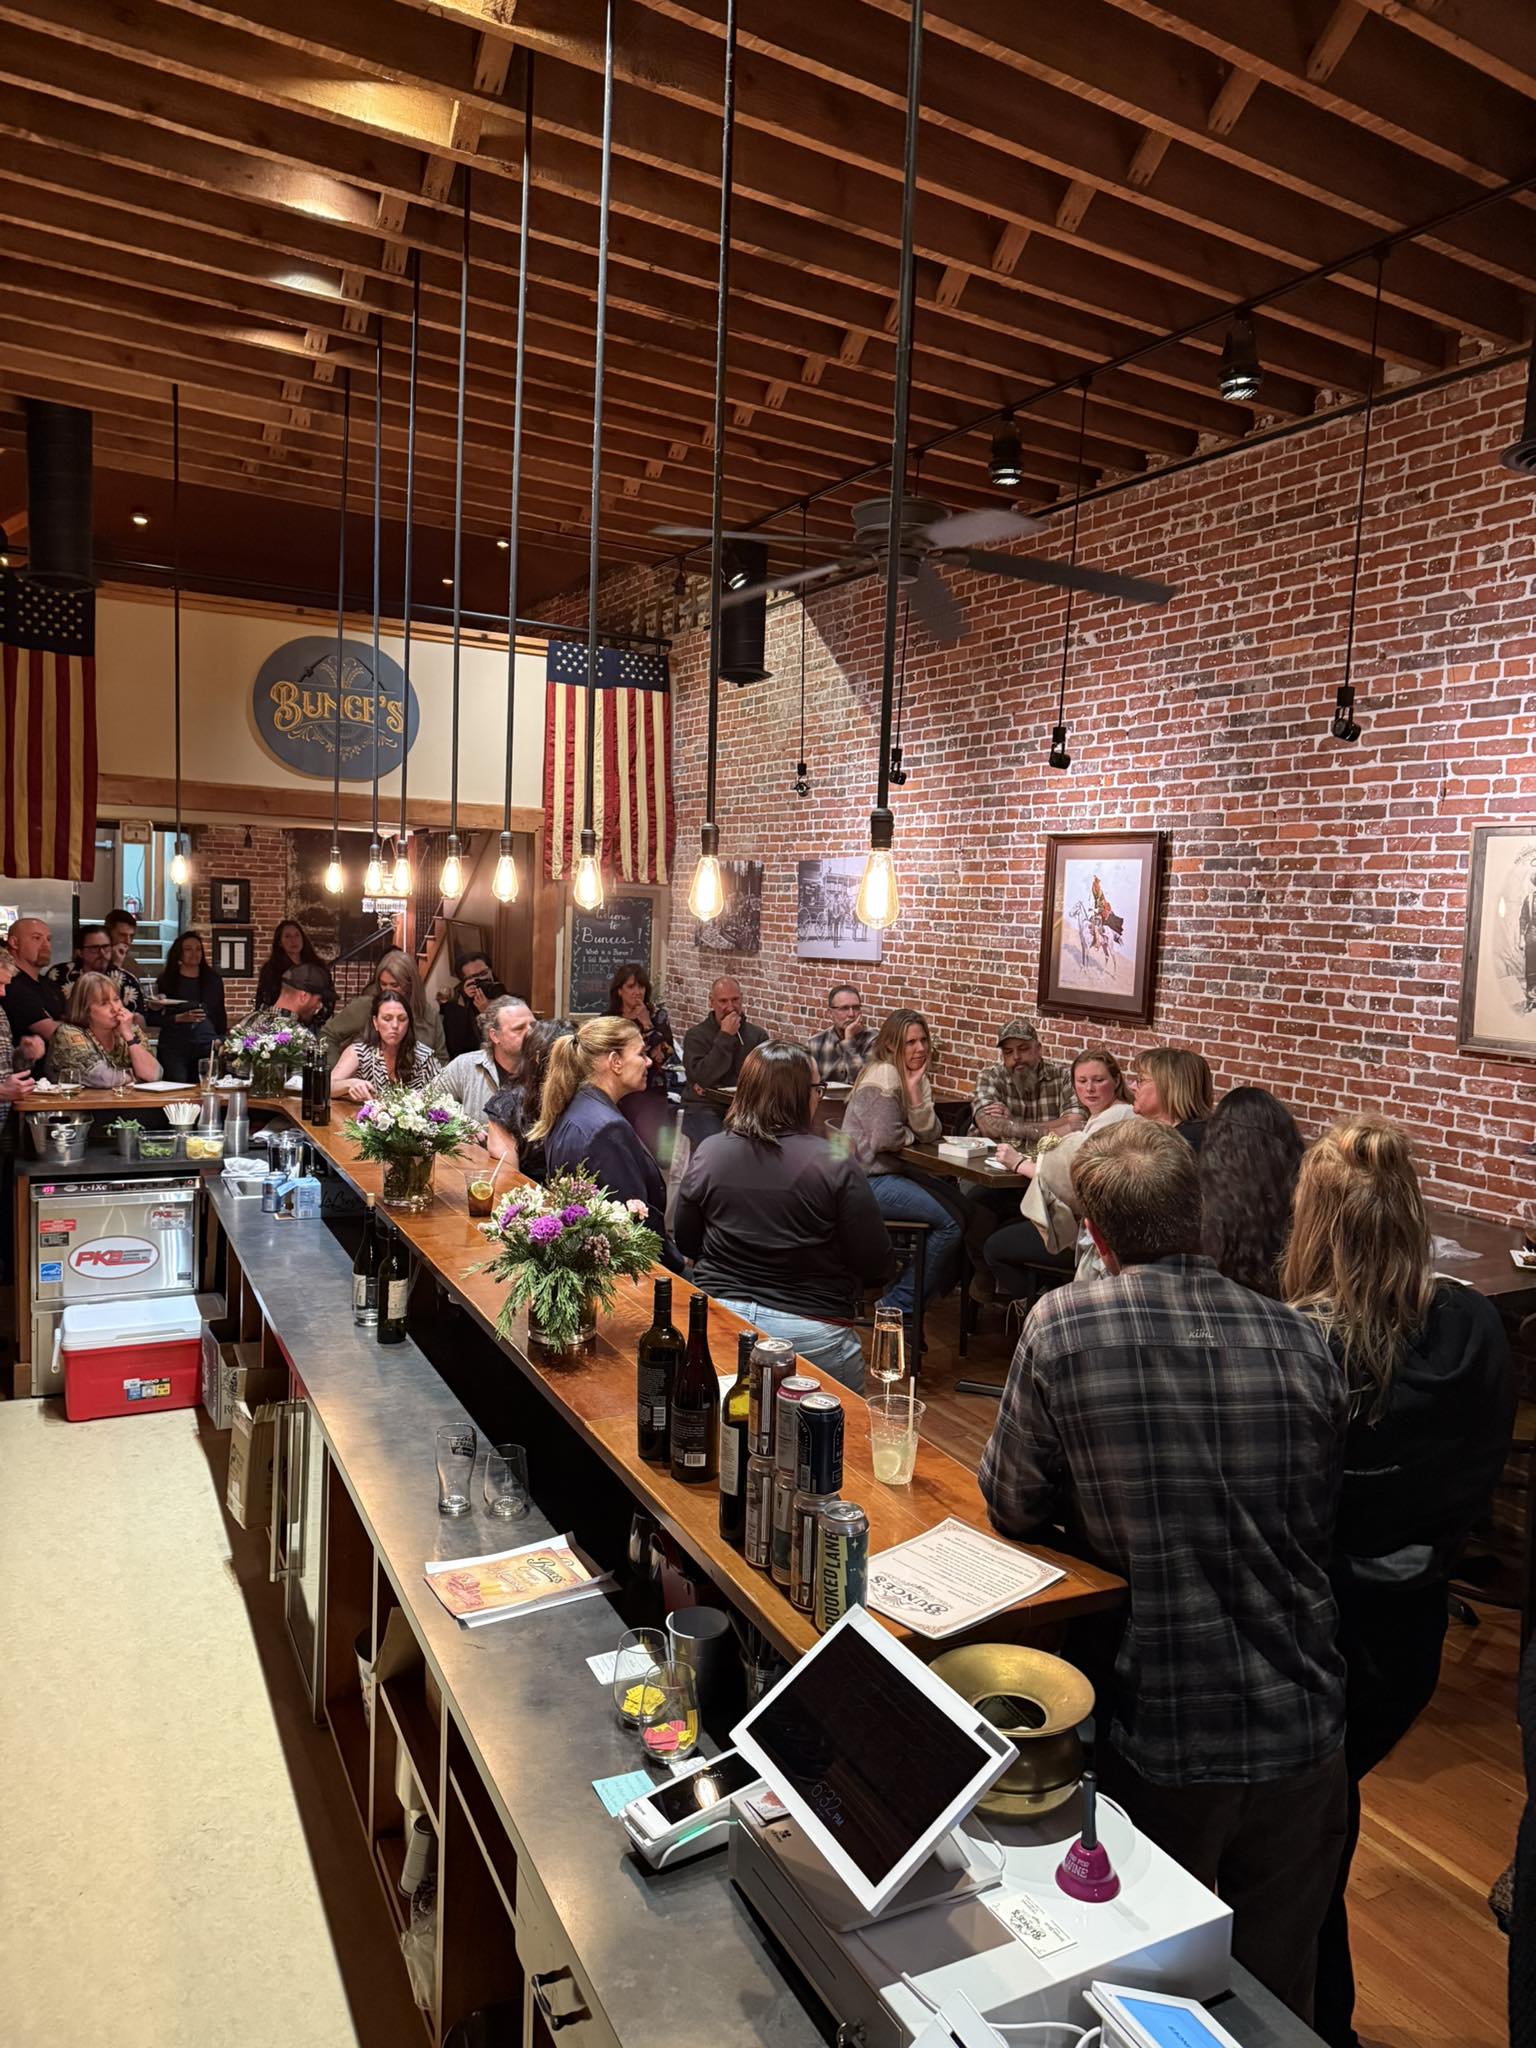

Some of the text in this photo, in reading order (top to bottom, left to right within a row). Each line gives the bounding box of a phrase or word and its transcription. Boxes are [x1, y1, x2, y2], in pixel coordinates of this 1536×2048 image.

[270, 680, 404, 734] BUNCE'S
[823, 1531, 841, 1632] ROOKED LANE
[810, 1779, 842, 1817] 6:32
[832, 1811, 846, 1827] PM
